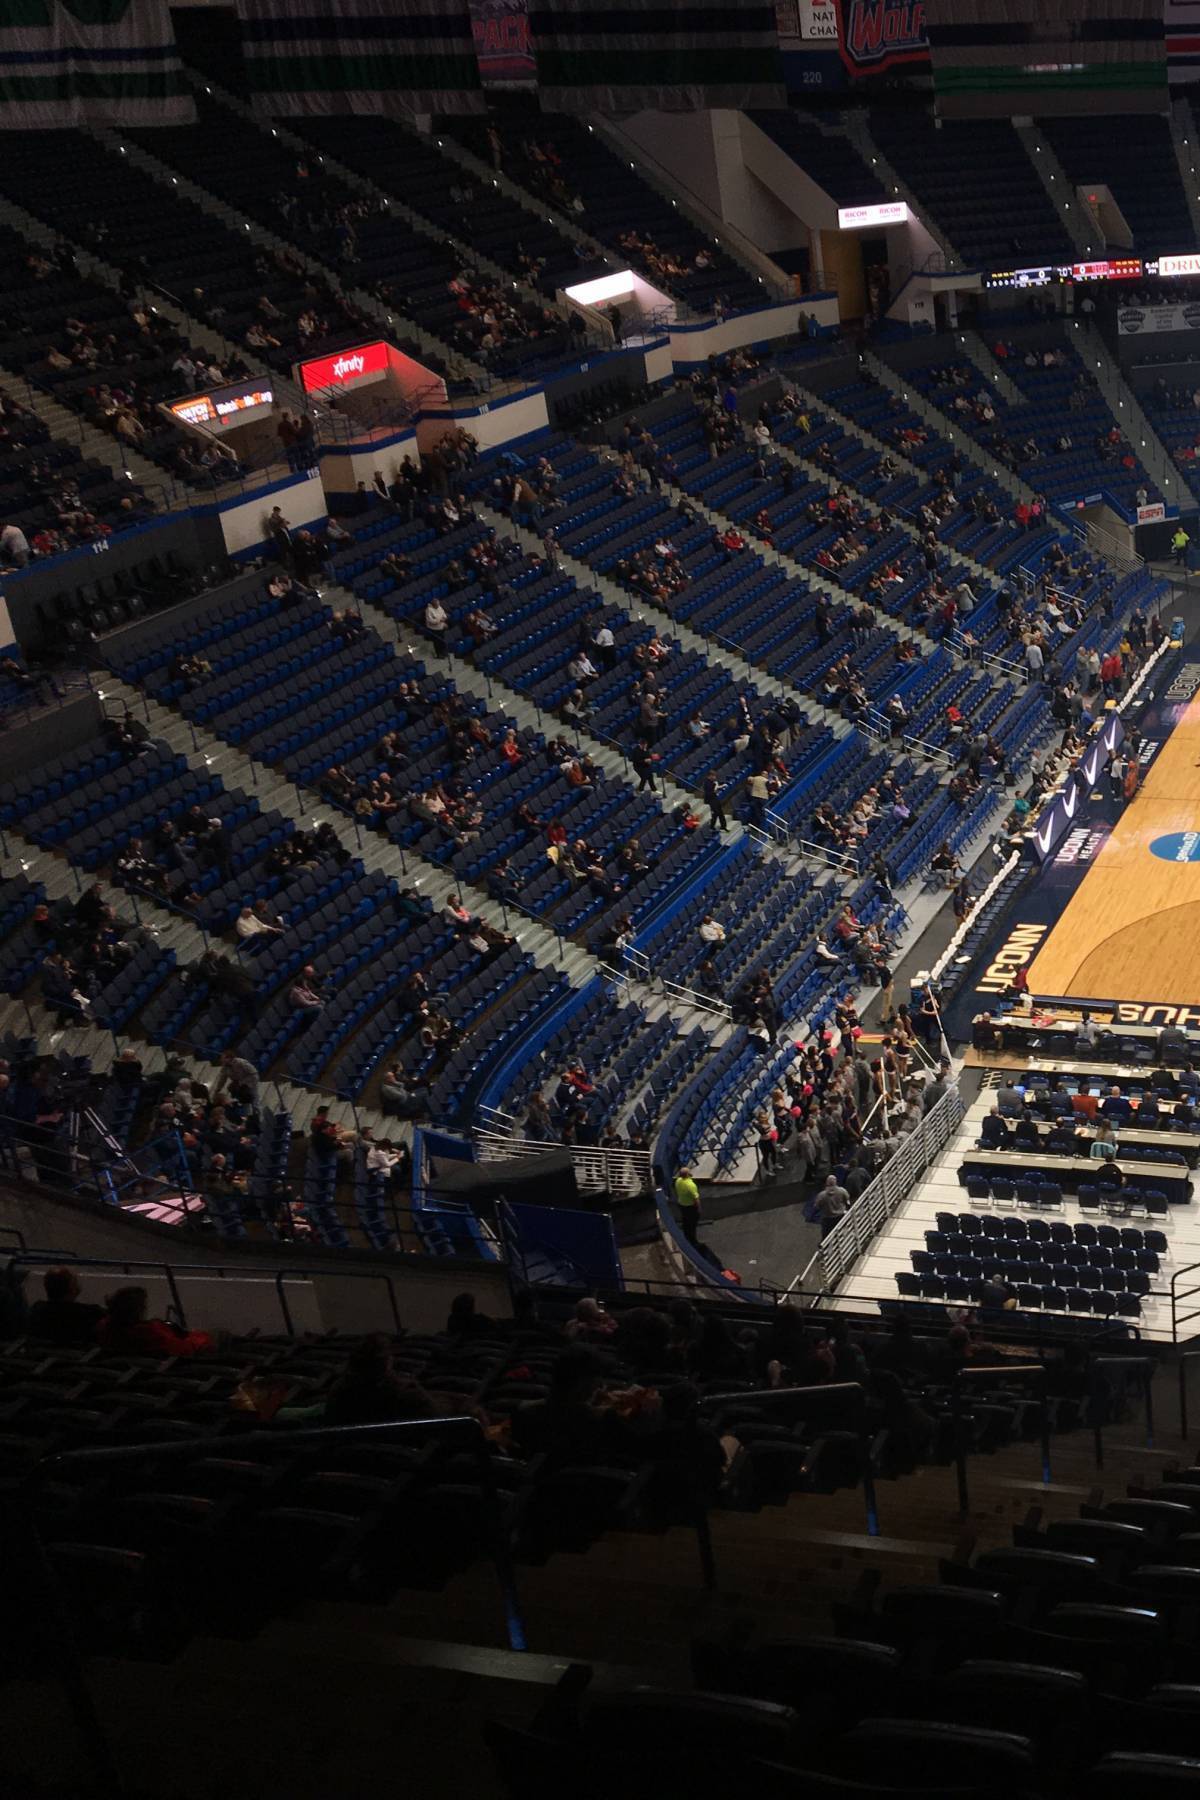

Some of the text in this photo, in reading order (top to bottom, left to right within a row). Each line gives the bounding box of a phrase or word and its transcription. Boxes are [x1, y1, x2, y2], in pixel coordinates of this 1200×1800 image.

[332, 354, 364, 378] xfinity
[1140, 508, 1163, 520] ESPN
[1054, 828, 1092, 863] UCONN
[1078, 832, 1104, 860] HEALTH
[975, 923, 1048, 993] UCONN
